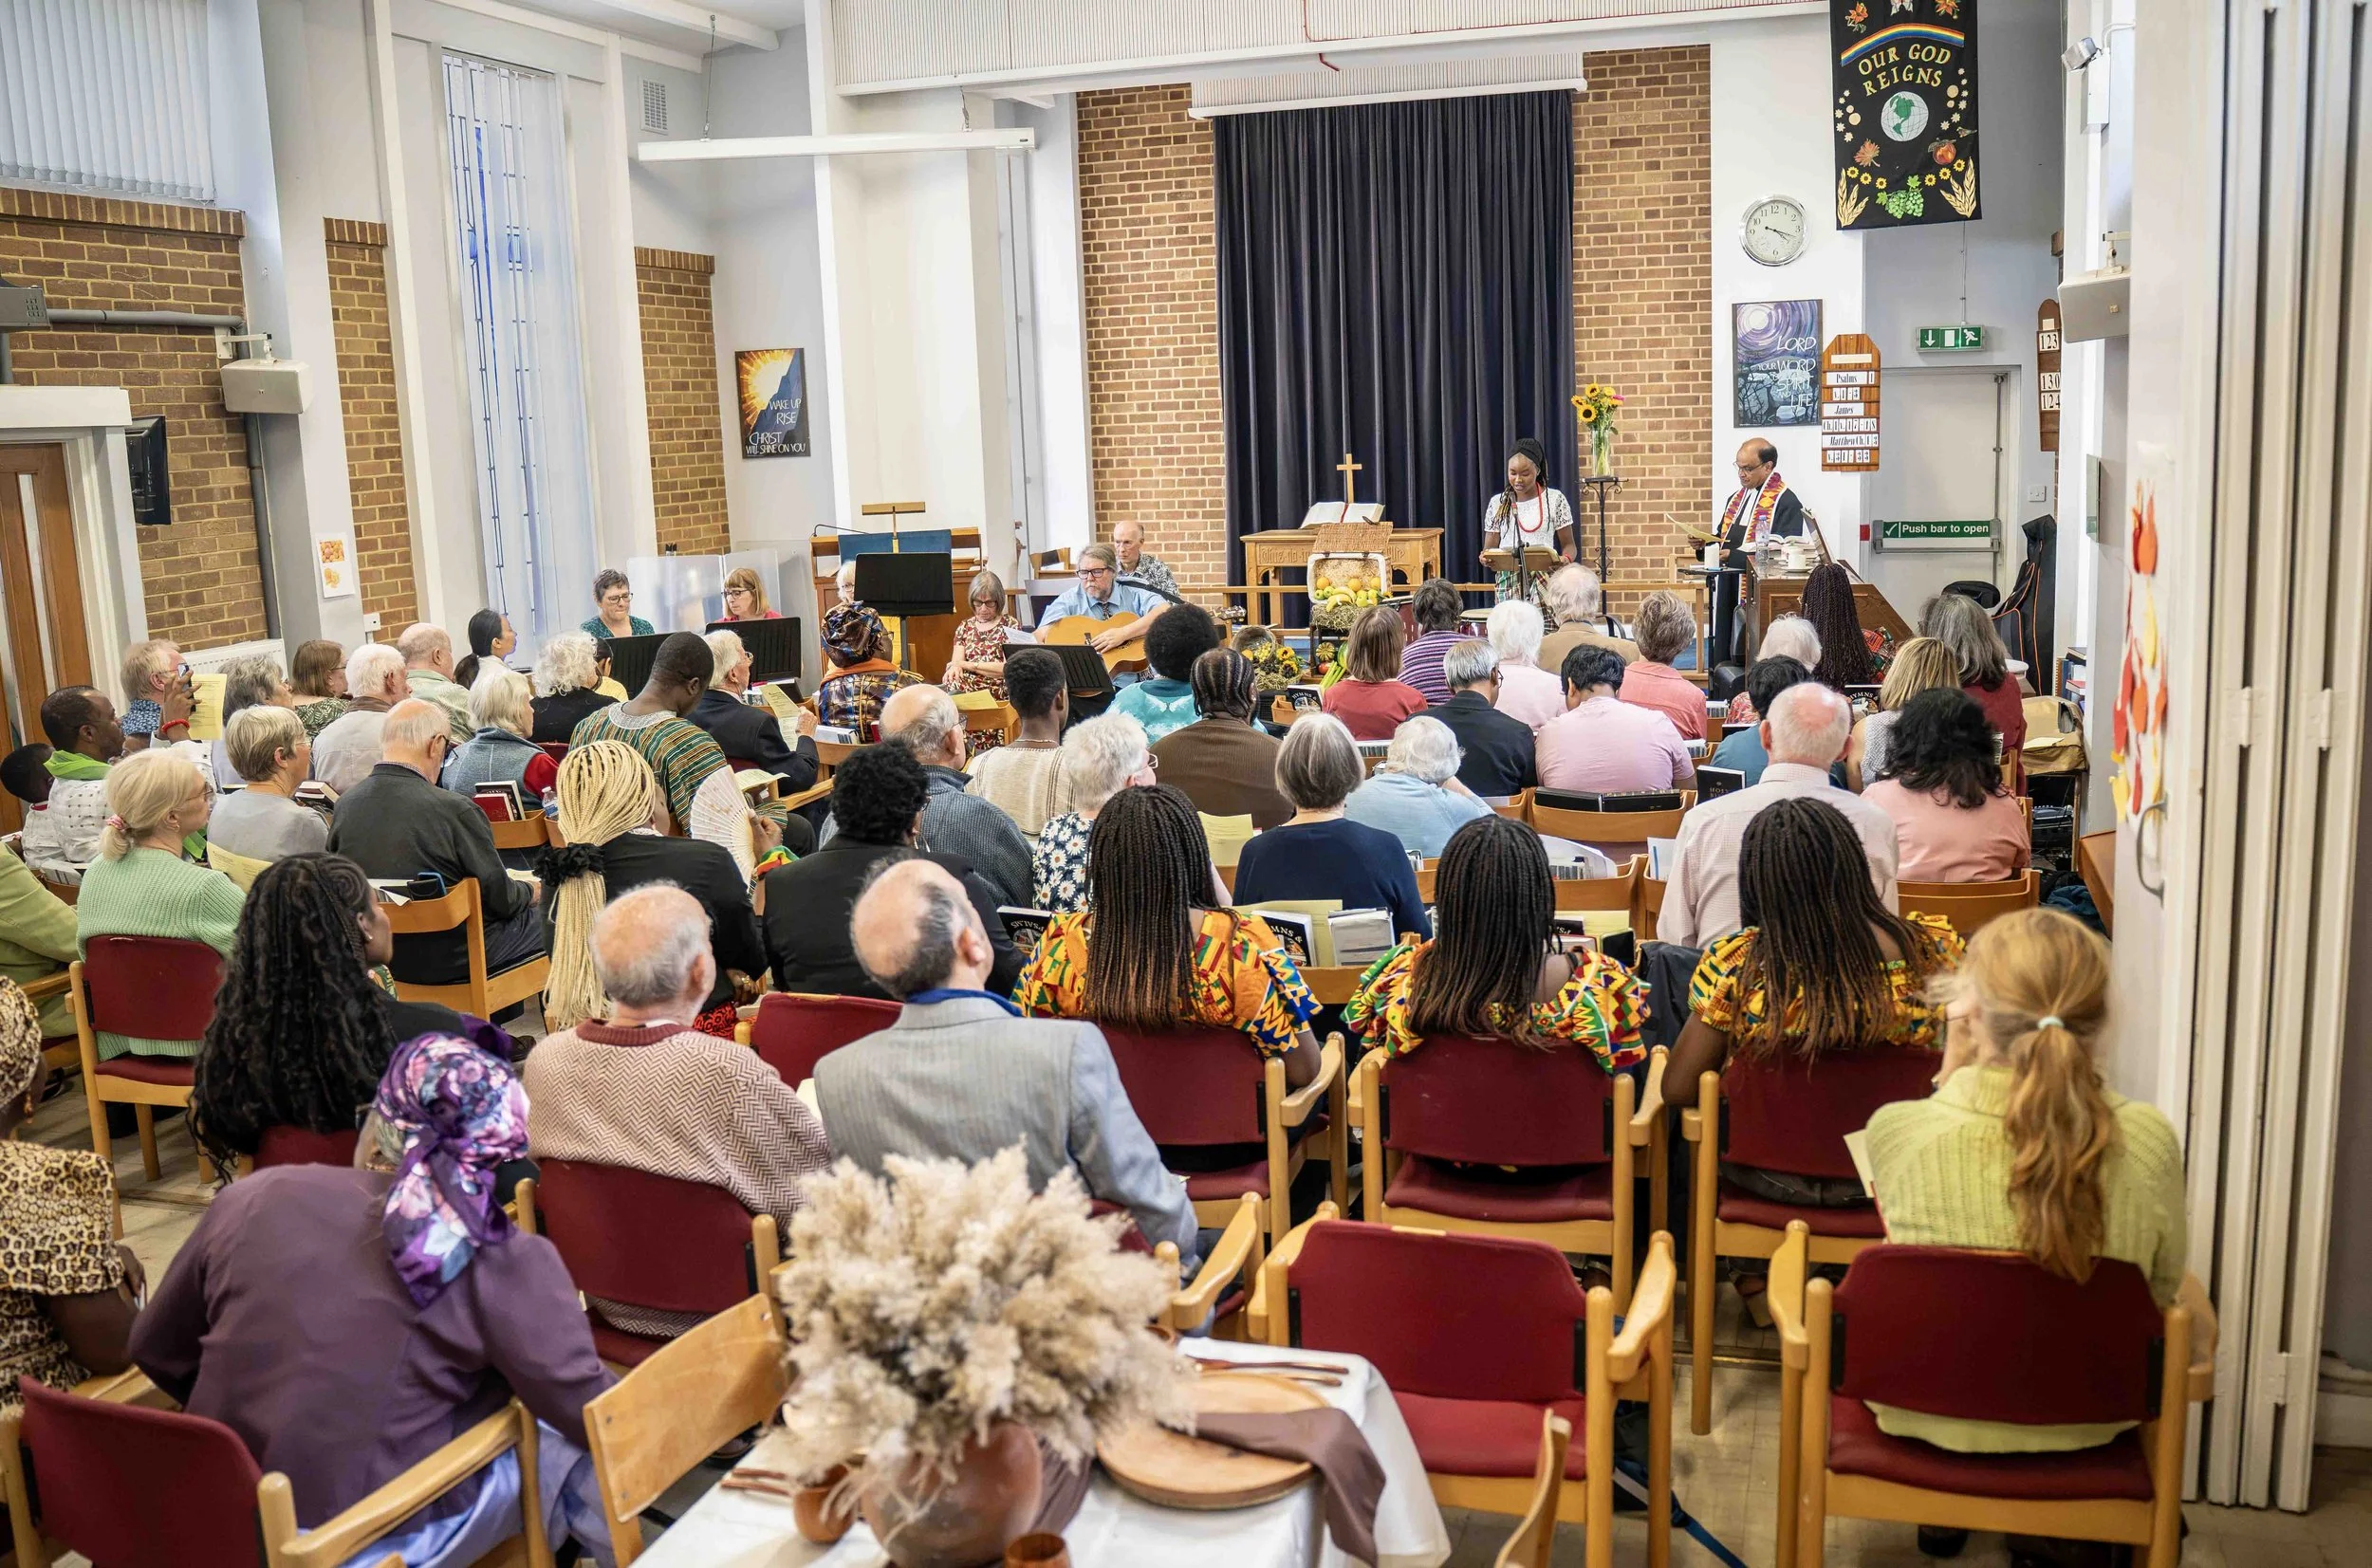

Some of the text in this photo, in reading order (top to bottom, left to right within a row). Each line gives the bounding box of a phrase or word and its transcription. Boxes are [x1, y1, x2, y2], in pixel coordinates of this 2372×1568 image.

[1858, 44, 1952, 76] OUR GOD
[1862, 65, 1942, 97] REIGNS
[1760, 209, 1768, 217] 11
[1770, 205, 1779, 213] 12
[1784, 207, 1788, 215] 1
[1753, 217, 1761, 226] 10
[1791, 213, 1797, 222] 2
[1795, 225, 1801, 233] 3
[1772, 248, 1779, 256] 6
[1776, 335, 1816, 352] LORD
[2041, 333, 2058, 350] 123
[1757, 359, 1816, 374] YOUR WORD
[1776, 375, 1814, 392] SPIRIT
[1836, 373, 1873, 384] Psalms 1
[2042, 374, 2060, 390] 130
[769, 398, 802, 410] WAKE UP
[1790, 392, 1813, 407] LIFE
[2043, 394, 2060, 410] 124
[1834, 405, 1854, 415] James
[776, 412, 797, 425] RISE
[749, 432, 782, 445] CHRIST
[1830, 435, 1856, 446] Matthew
[746, 442, 806, 454] WILL SHINE ON YOU
[1902, 524, 1989, 535] Push bar to open
[1270, 925, 1294, 937] MNS
